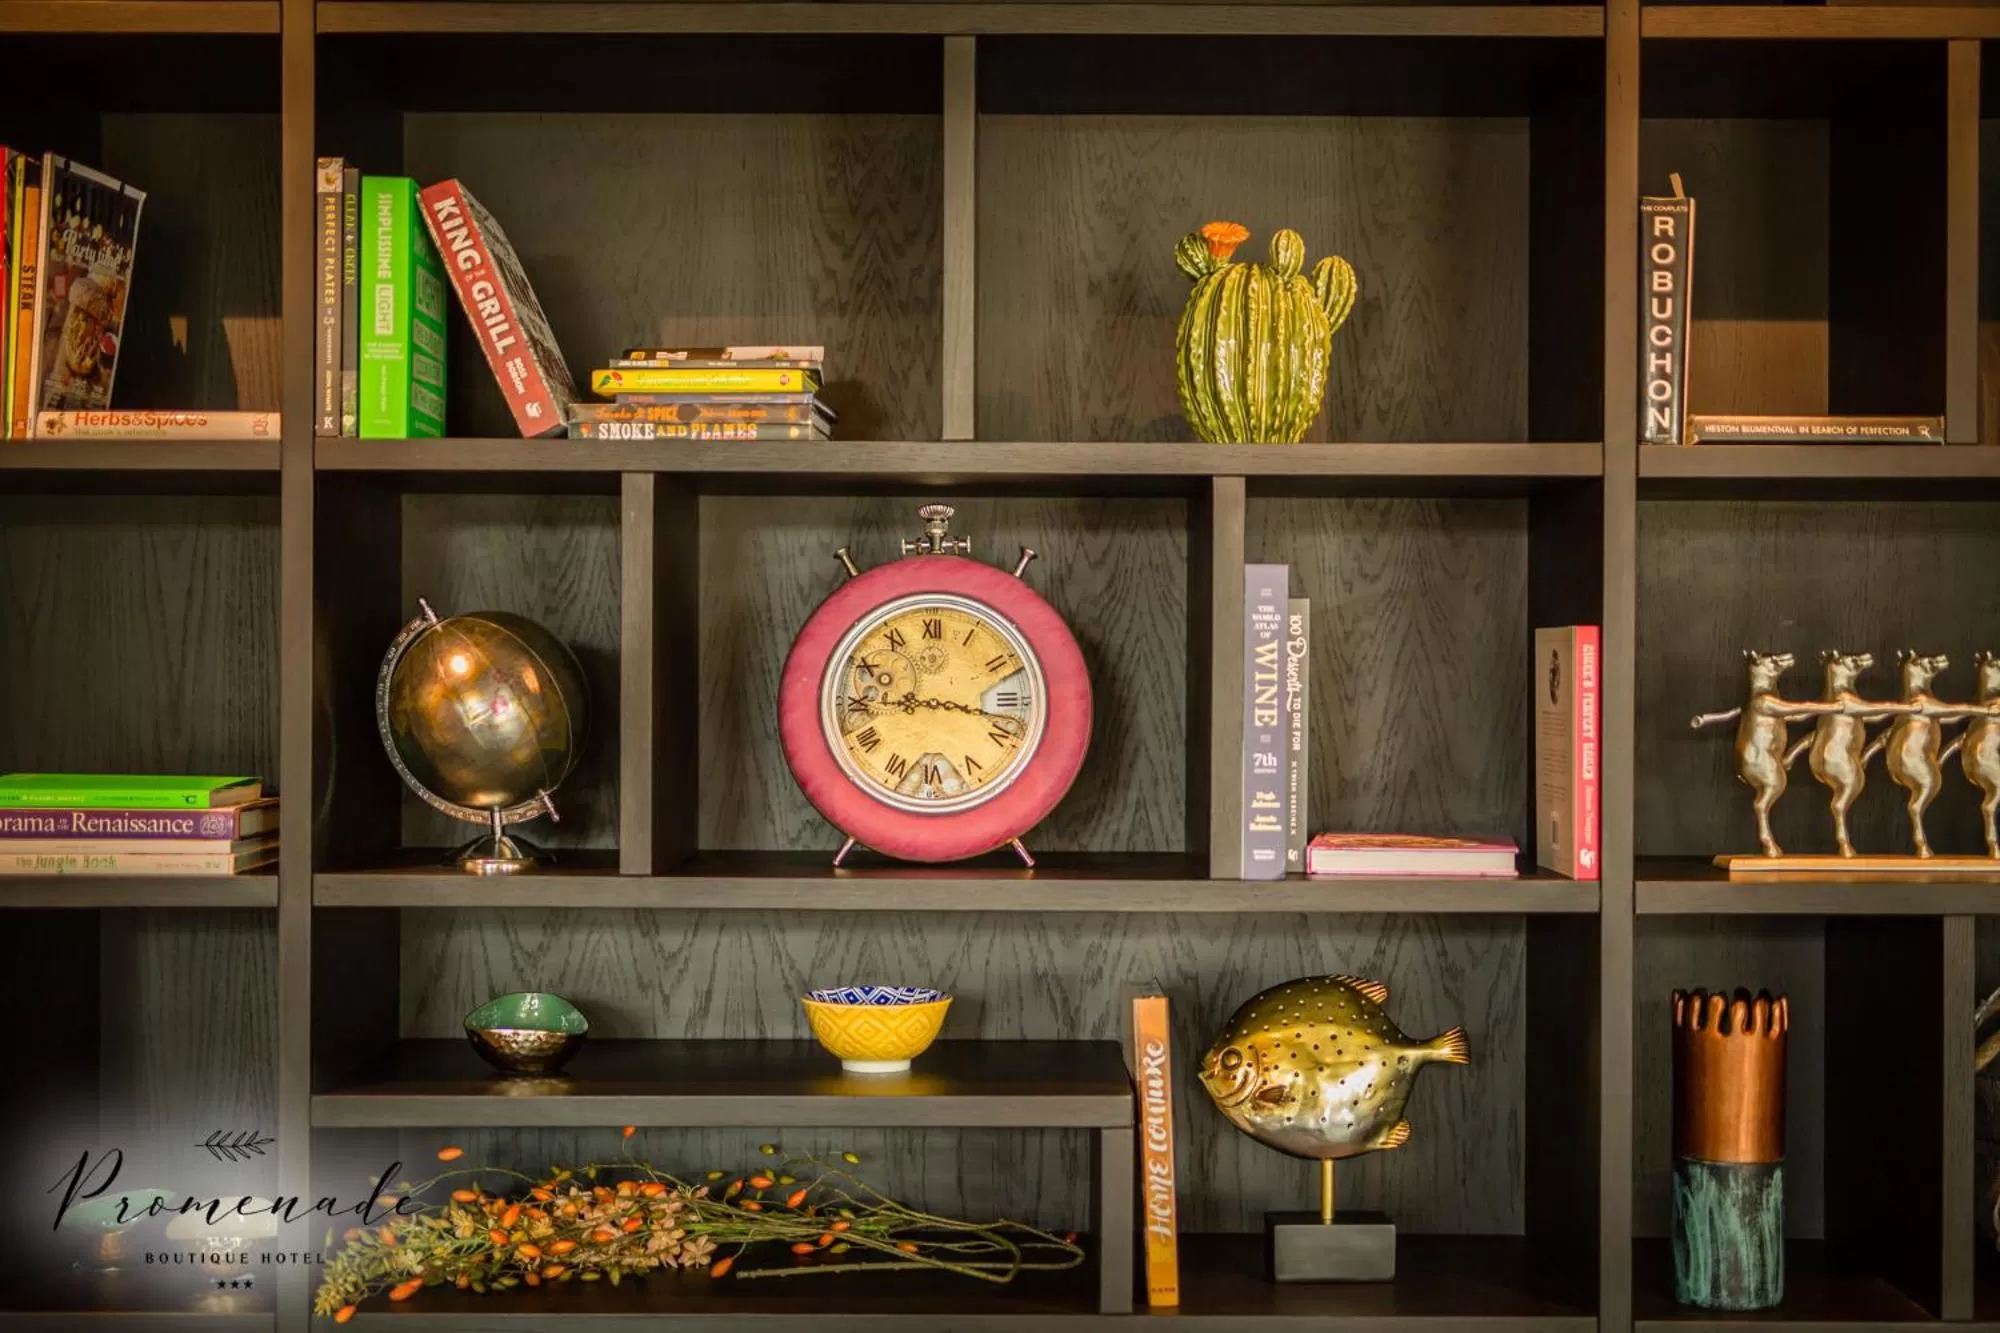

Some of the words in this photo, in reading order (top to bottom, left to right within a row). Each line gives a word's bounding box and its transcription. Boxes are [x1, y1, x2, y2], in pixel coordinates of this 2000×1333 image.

[325, 197, 336, 254] PERFECT
[377, 193, 392, 279] SIMPLISSIME
[325, 257, 336, 305] PLATES
[433, 197, 482, 272] KING
[471, 280, 516, 354] GRILL
[20, 265, 36, 311] STEAK
[378, 287, 391, 332] LIGHT
[1648, 215, 1676, 429] ROBUCHON
[598, 423, 655, 440] SMOKE
[656, 425, 688, 437] AND
[690, 423, 758, 440] FLAMES
[1705, 424, 1739, 433] HESTON
[1811, 425, 1844, 435] SEARCH
[1846, 426, 1857, 435] OF
[1860, 426, 1910, 435] PERFECTION
[1258, 605, 1276, 613] THE
[922, 619, 942, 640] XII
[1260, 631, 1272, 639] OF
[1289, 614, 1302, 635] 100
[855, 657, 880, 678] X
[985, 655, 1007, 672] II
[1254, 639, 1278, 727] WINE
[1286, 637, 1307, 712] Desserts
[996, 692, 1018, 707] III
[1292, 697, 1301, 709] TO
[1292, 711, 1301, 729] DIE
[1292, 731, 1301, 751] FOR
[964, 755, 982, 775] V
[1253, 752, 1277, 767] 7th
[72, 812, 194, 833] Renaissance
